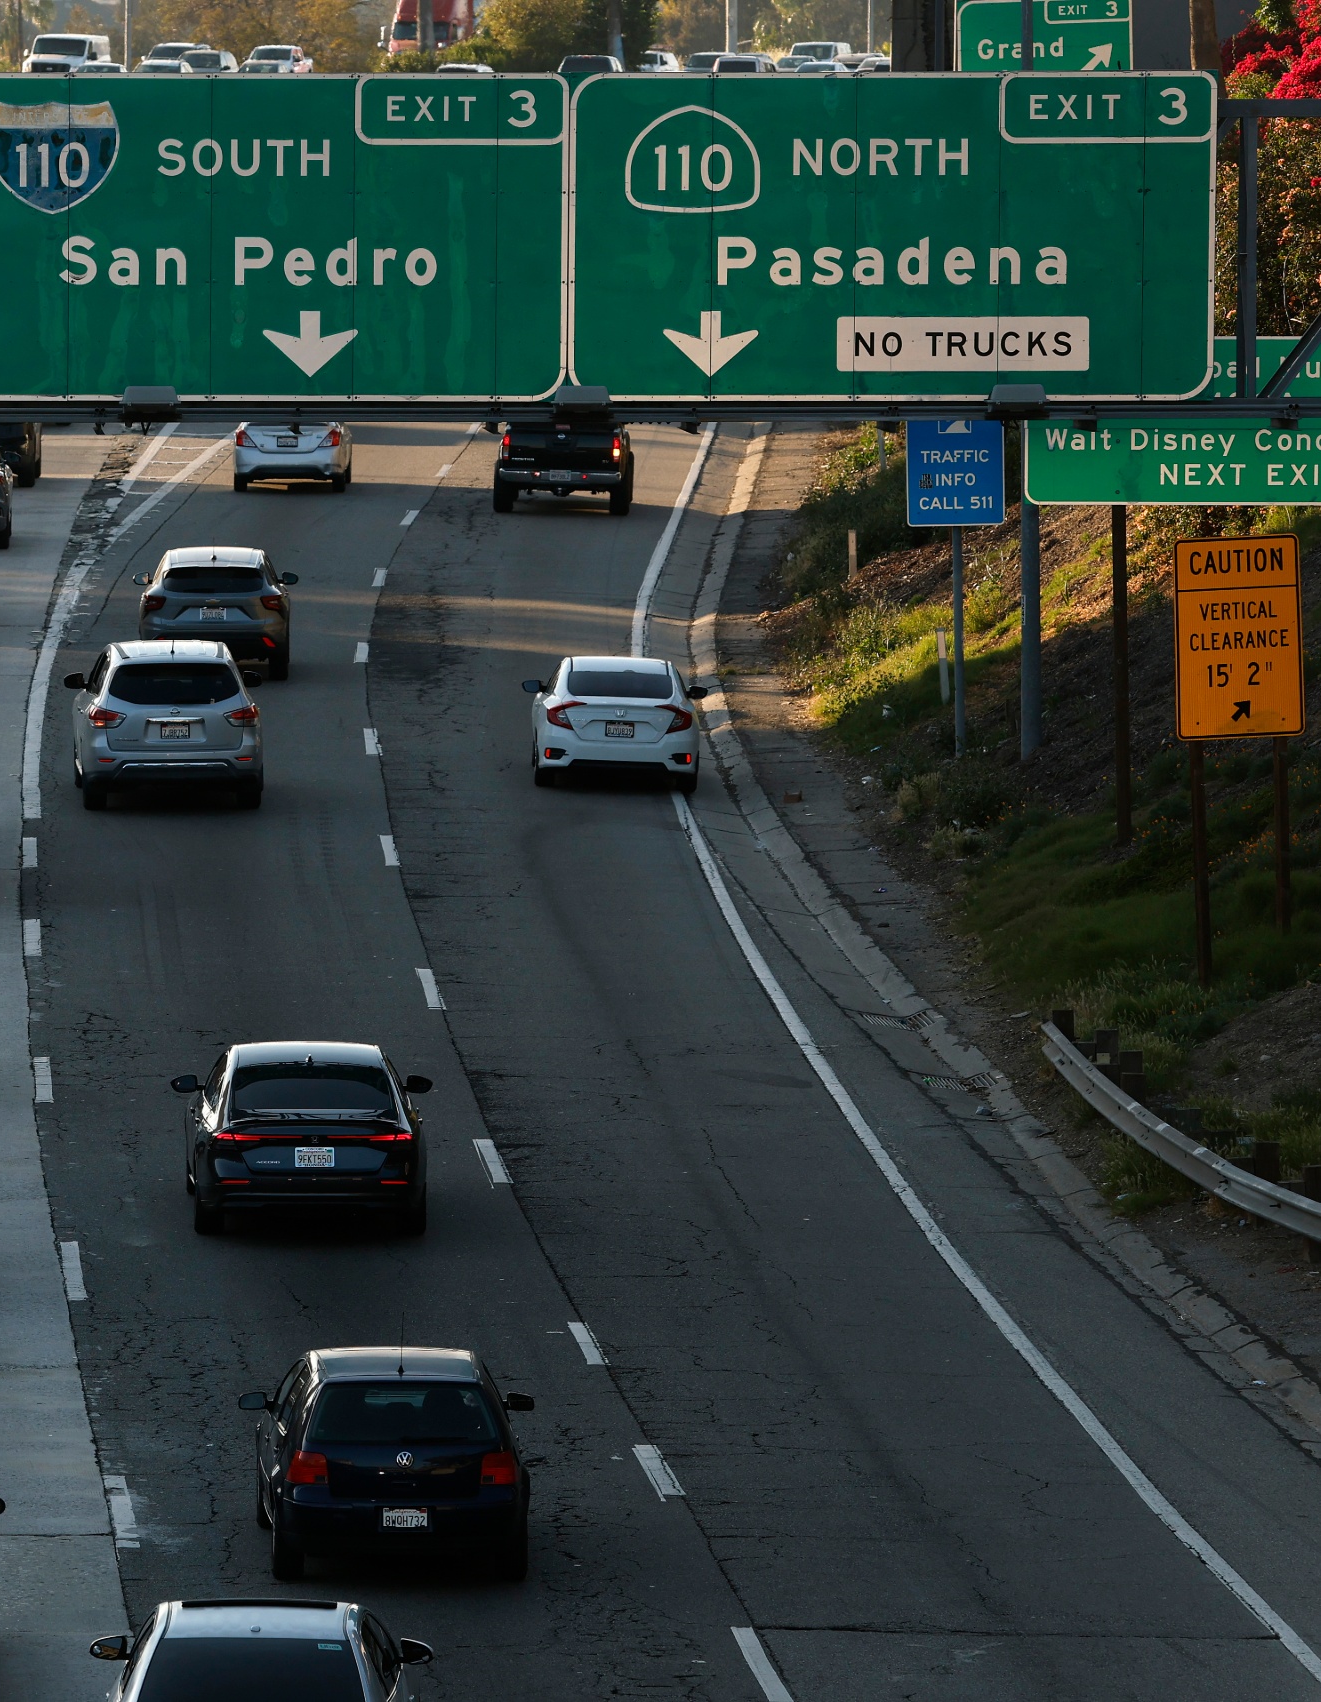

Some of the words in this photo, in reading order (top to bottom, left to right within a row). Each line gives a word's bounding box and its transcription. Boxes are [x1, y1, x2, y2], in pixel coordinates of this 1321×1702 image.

[1058, 5, 1088, 16] EXIT
[1105, 1, 1118, 17] 3
[977, 36, 1064, 60] Grand
[386, 96, 477, 122] EXIT
[507, 90, 537, 127] 3
[1029, 94, 1121, 120] EXIT
[1158, 87, 1188, 126] 3
[15, 142, 90, 188] 110
[157, 138, 331, 177] SOUTH
[654, 143, 733, 192] 110
[792, 138, 969, 176] NORTH
[59, 235, 187, 287] San
[234, 236, 437, 287] Pedro
[717, 236, 1068, 286] Pasadena
[854, 331, 903, 357] NO
[926, 331, 1072, 357] TRUCKS
[1045, 428, 1112, 451] Walt
[1130, 428, 1236, 456] Disney
[920, 449, 990, 464] TRAFFIC
[935, 473, 976, 487] INFO
[1160, 463, 1246, 486] NEXT
[919, 496, 964, 510] CALL
[970, 495, 993, 509] 511
[1189, 547, 1284, 576] CAUTION
[1199, 601, 1278, 622] VERTICAL
[1190, 629, 1290, 651] CLEARANCE
[297, 1154, 332, 1164] 9FKT550
[385, 1515, 426, 1527] 8WQH732
